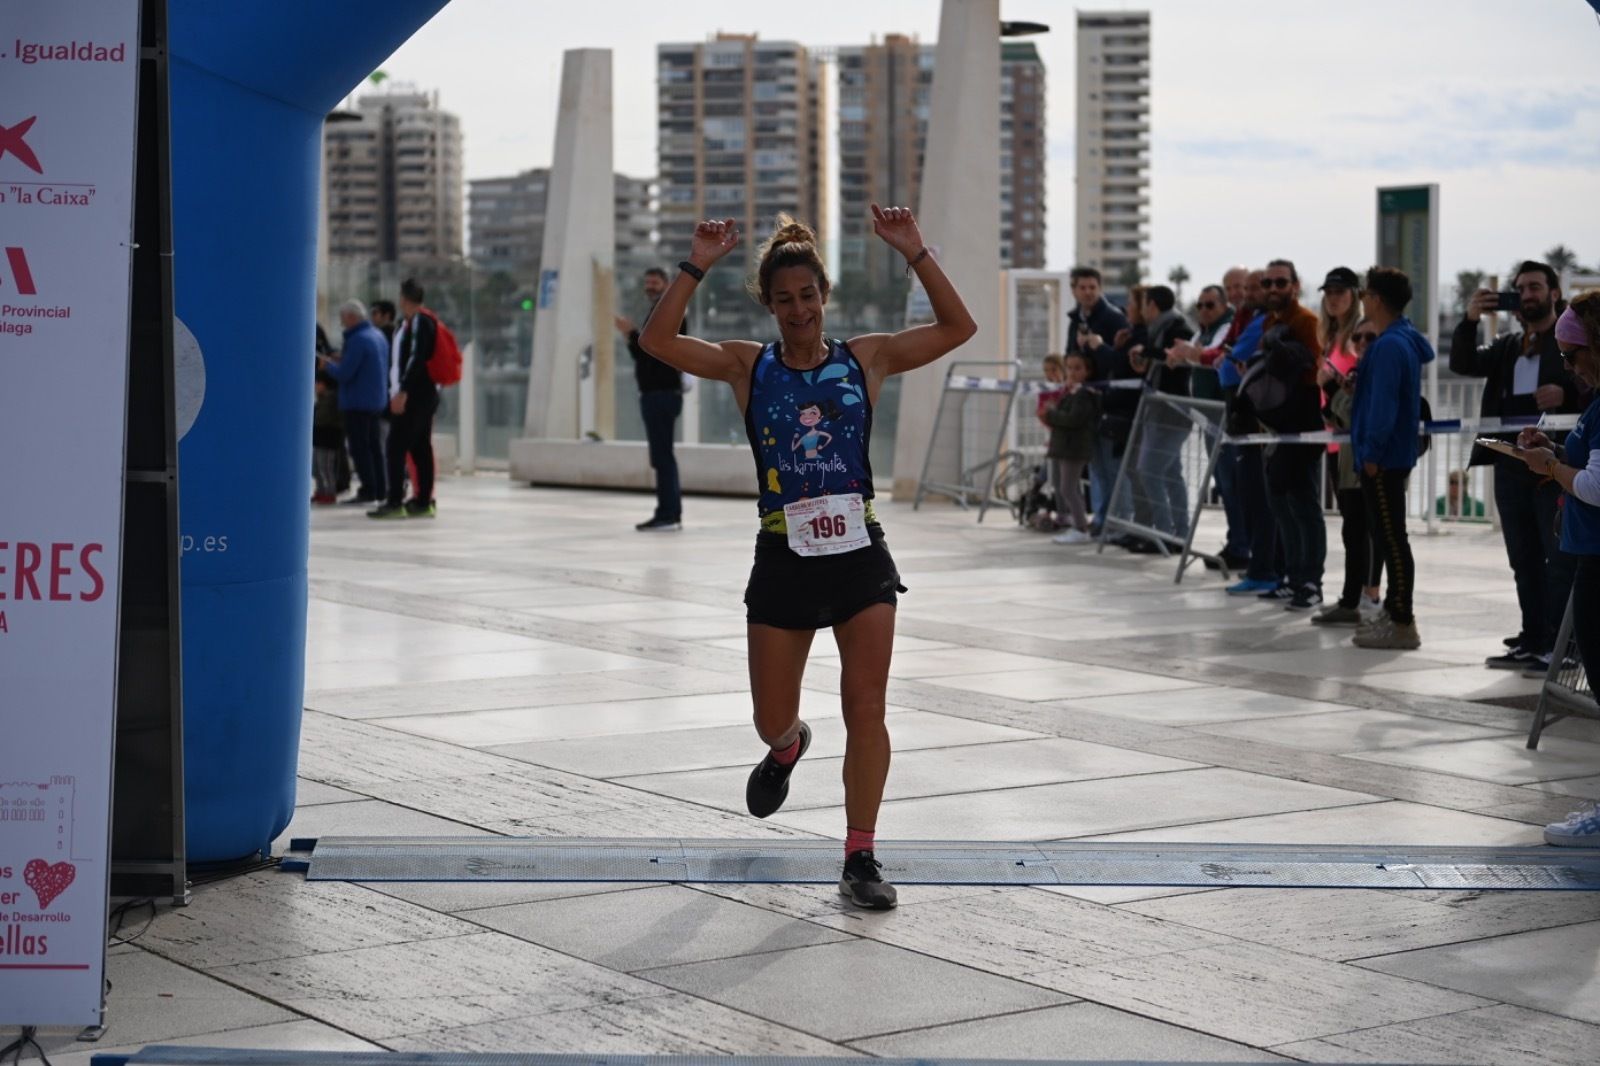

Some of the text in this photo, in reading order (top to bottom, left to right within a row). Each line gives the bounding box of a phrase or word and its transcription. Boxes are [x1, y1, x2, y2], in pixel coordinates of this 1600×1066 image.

[14, 39, 125, 63] Igualdad
[2, 305, 71, 319] Provincial
[809, 514, 846, 539] 196
[12, 911, 71, 923] Desarrollo
